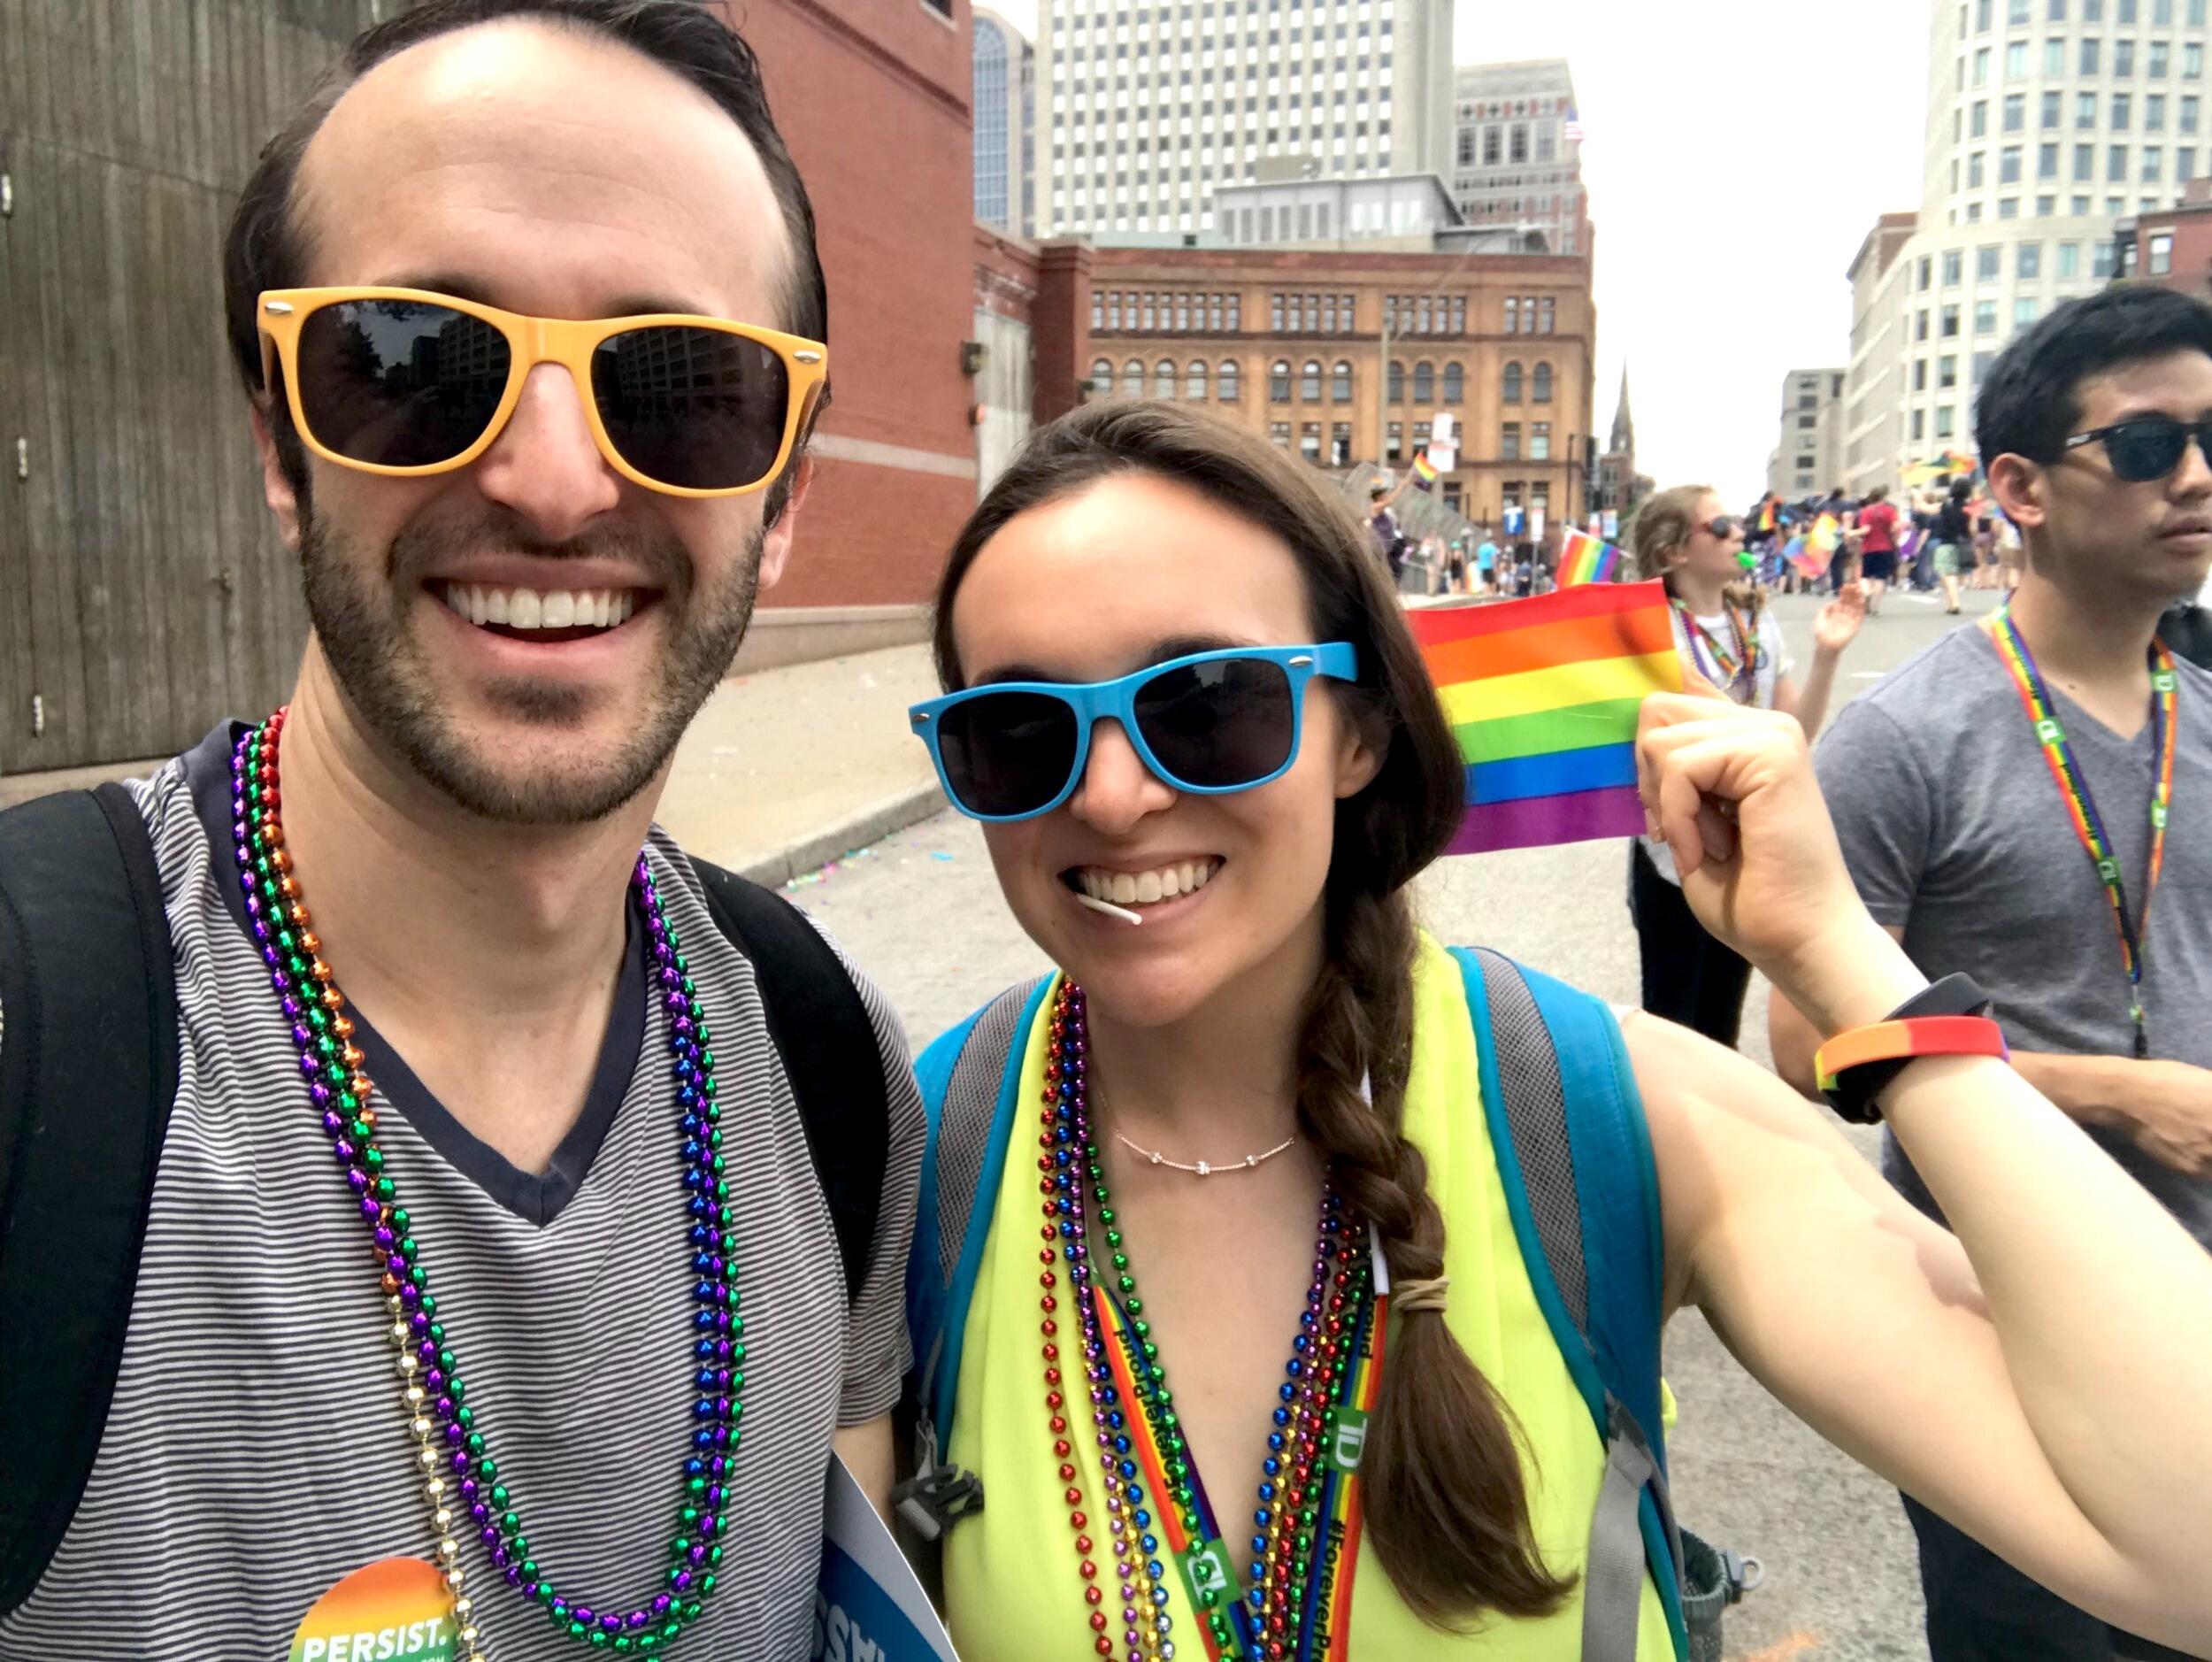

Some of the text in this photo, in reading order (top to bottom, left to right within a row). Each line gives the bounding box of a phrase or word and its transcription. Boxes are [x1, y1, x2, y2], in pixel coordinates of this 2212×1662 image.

[1334, 1418, 1368, 1468] TD
[1311, 1518, 1346, 1662] #ForeverPr
[302, 1617, 448, 1662] PERSIST.
